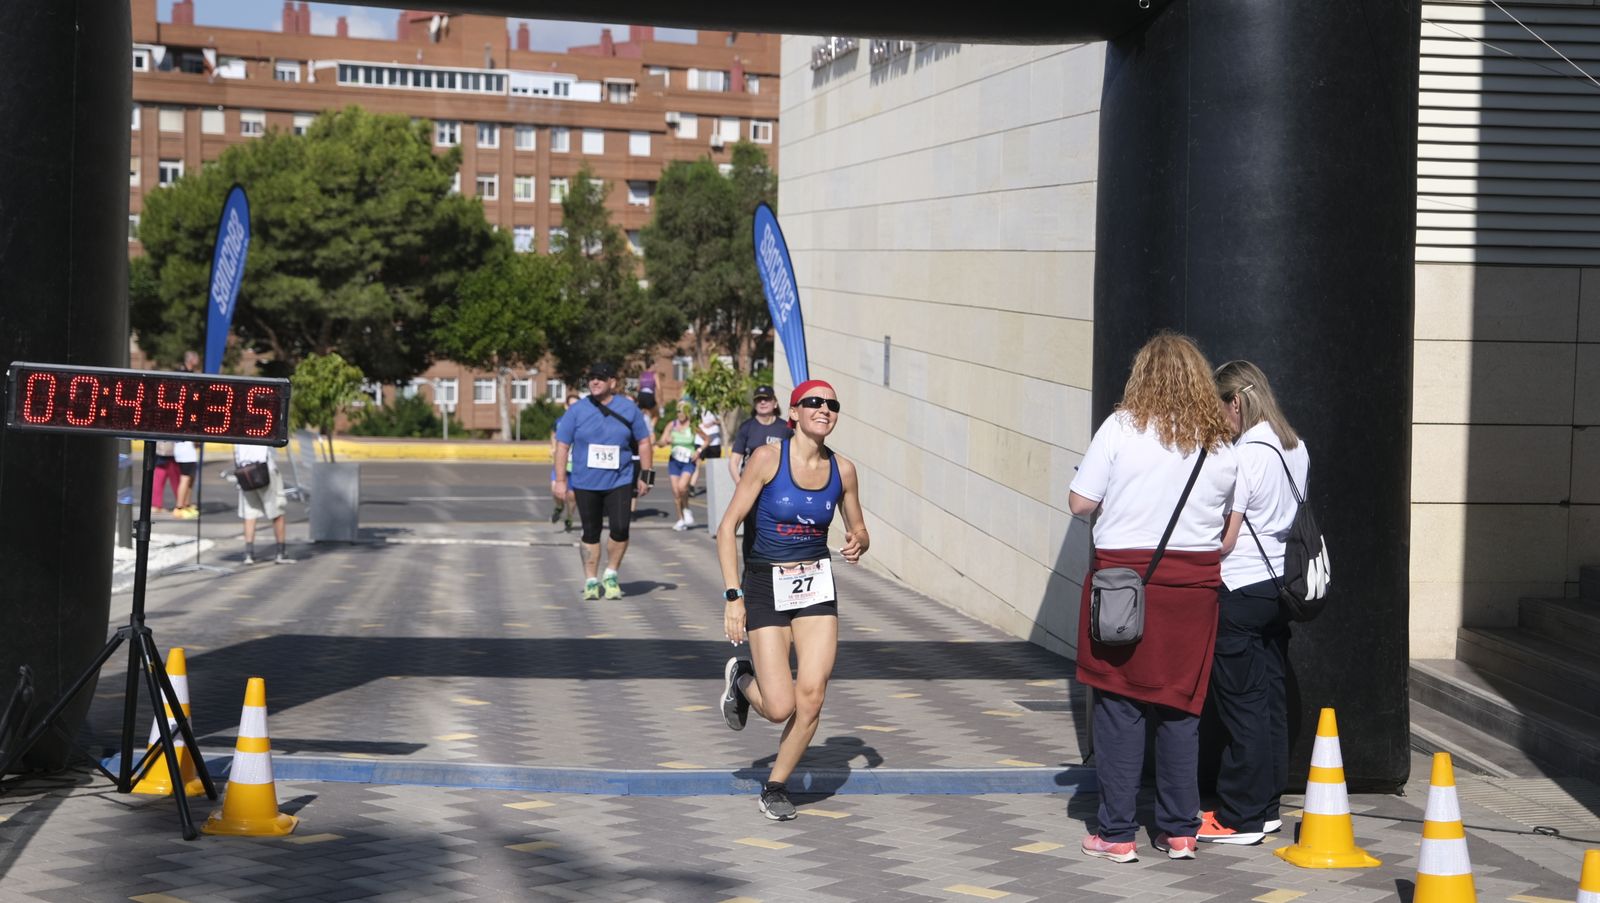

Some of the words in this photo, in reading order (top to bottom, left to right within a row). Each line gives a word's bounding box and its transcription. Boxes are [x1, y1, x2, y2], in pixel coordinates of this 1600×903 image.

[23, 372, 275, 437] 00:44:35
[595, 452, 614, 461] 135
[791, 576, 814, 594] 27
